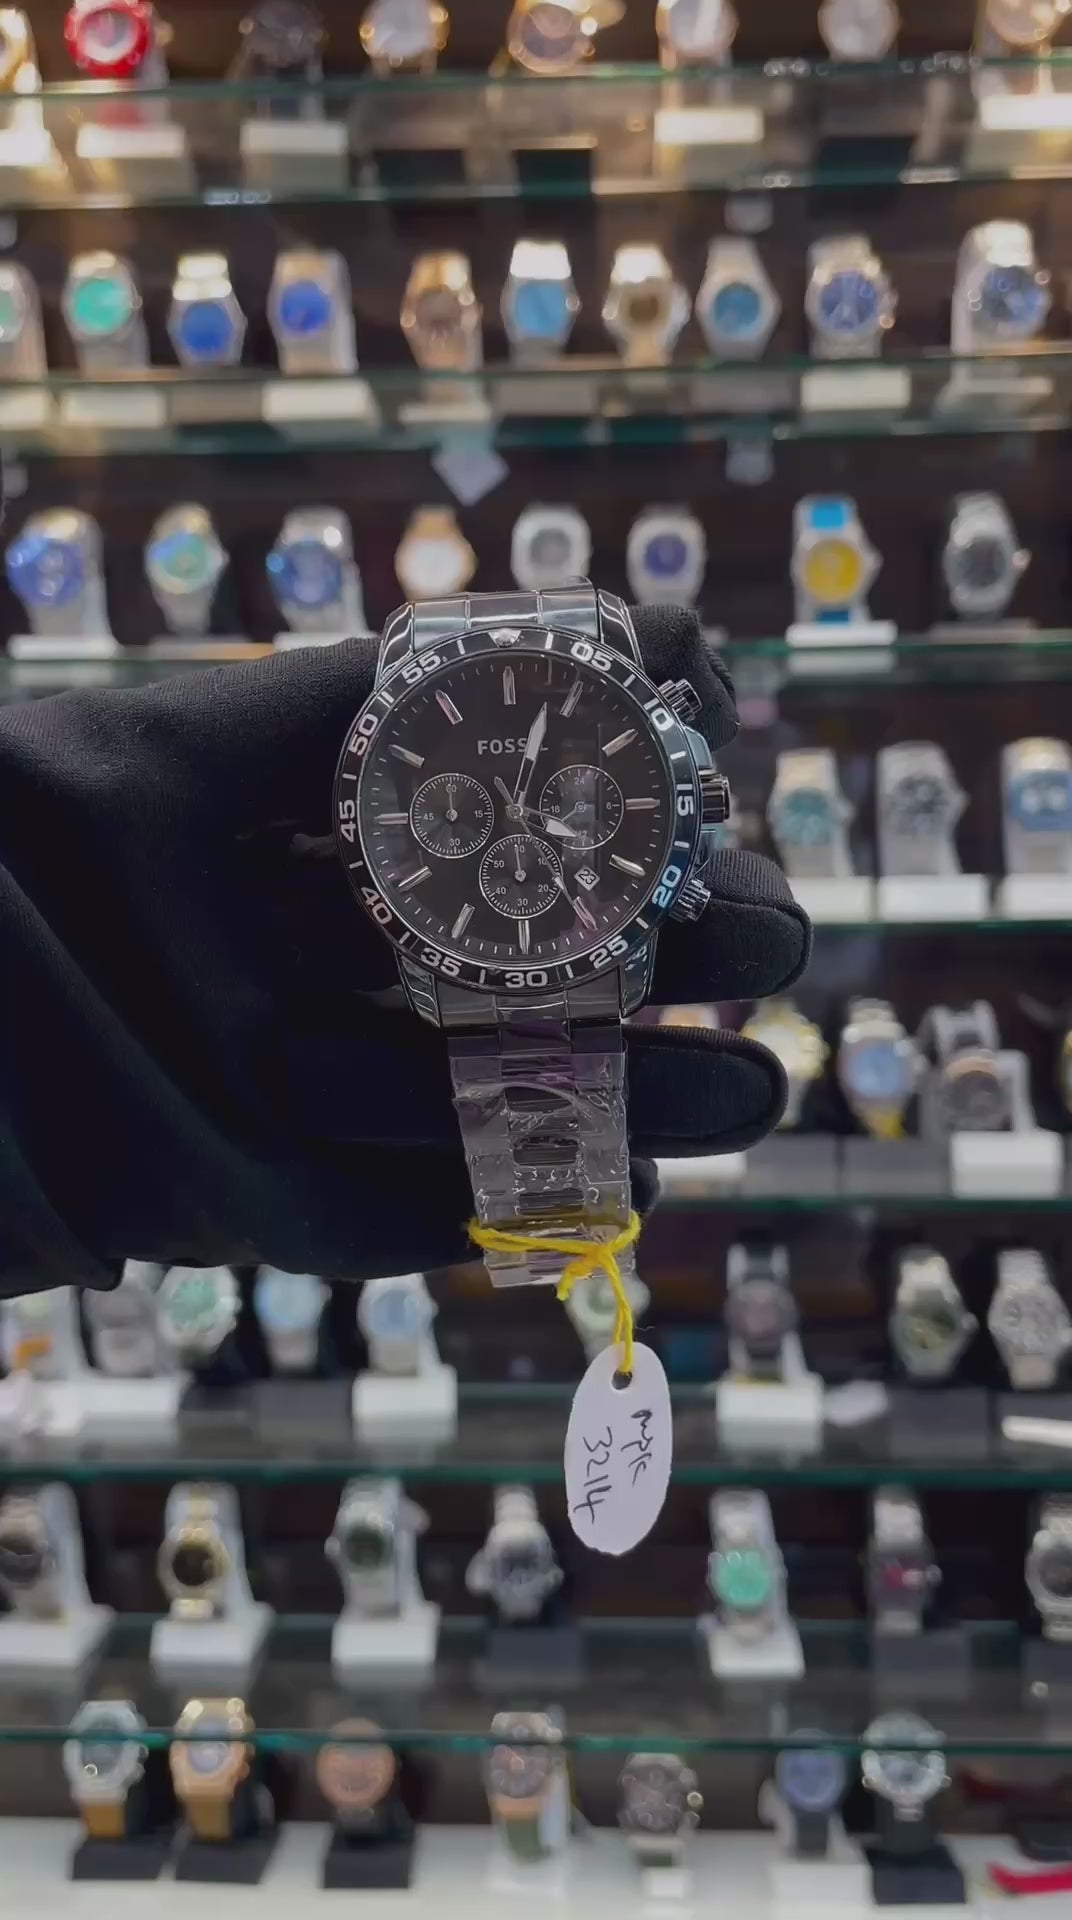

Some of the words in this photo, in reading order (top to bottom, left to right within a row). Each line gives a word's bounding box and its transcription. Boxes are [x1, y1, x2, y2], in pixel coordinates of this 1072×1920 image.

[570, 641, 614, 672] 05
[401, 649, 442, 685] 55
[643, 698, 675, 731] 10
[348, 713, 379, 756] 50
[477, 737, 549, 755] FOSSL
[574, 777, 585, 785] 24
[606, 802, 612, 810] 6
[676, 784, 694, 817] 15
[340, 799, 356, 843] 45
[423, 812, 435, 821] 45
[474, 810, 484, 818] 15
[449, 837, 461, 846] 30
[493, 860, 505, 869] 50
[578, 868, 597, 885] 23
[495, 886, 507, 895] 40
[537, 884, 549, 893] 20
[652, 864, 682, 909] 20
[360, 886, 392, 924] 40
[516, 898, 528, 906] 30
[420, 947, 462, 977] 35
[589, 935, 629, 970] 25
[504, 970, 548, 989] 30
[572, 1425, 613, 1525] 3214
